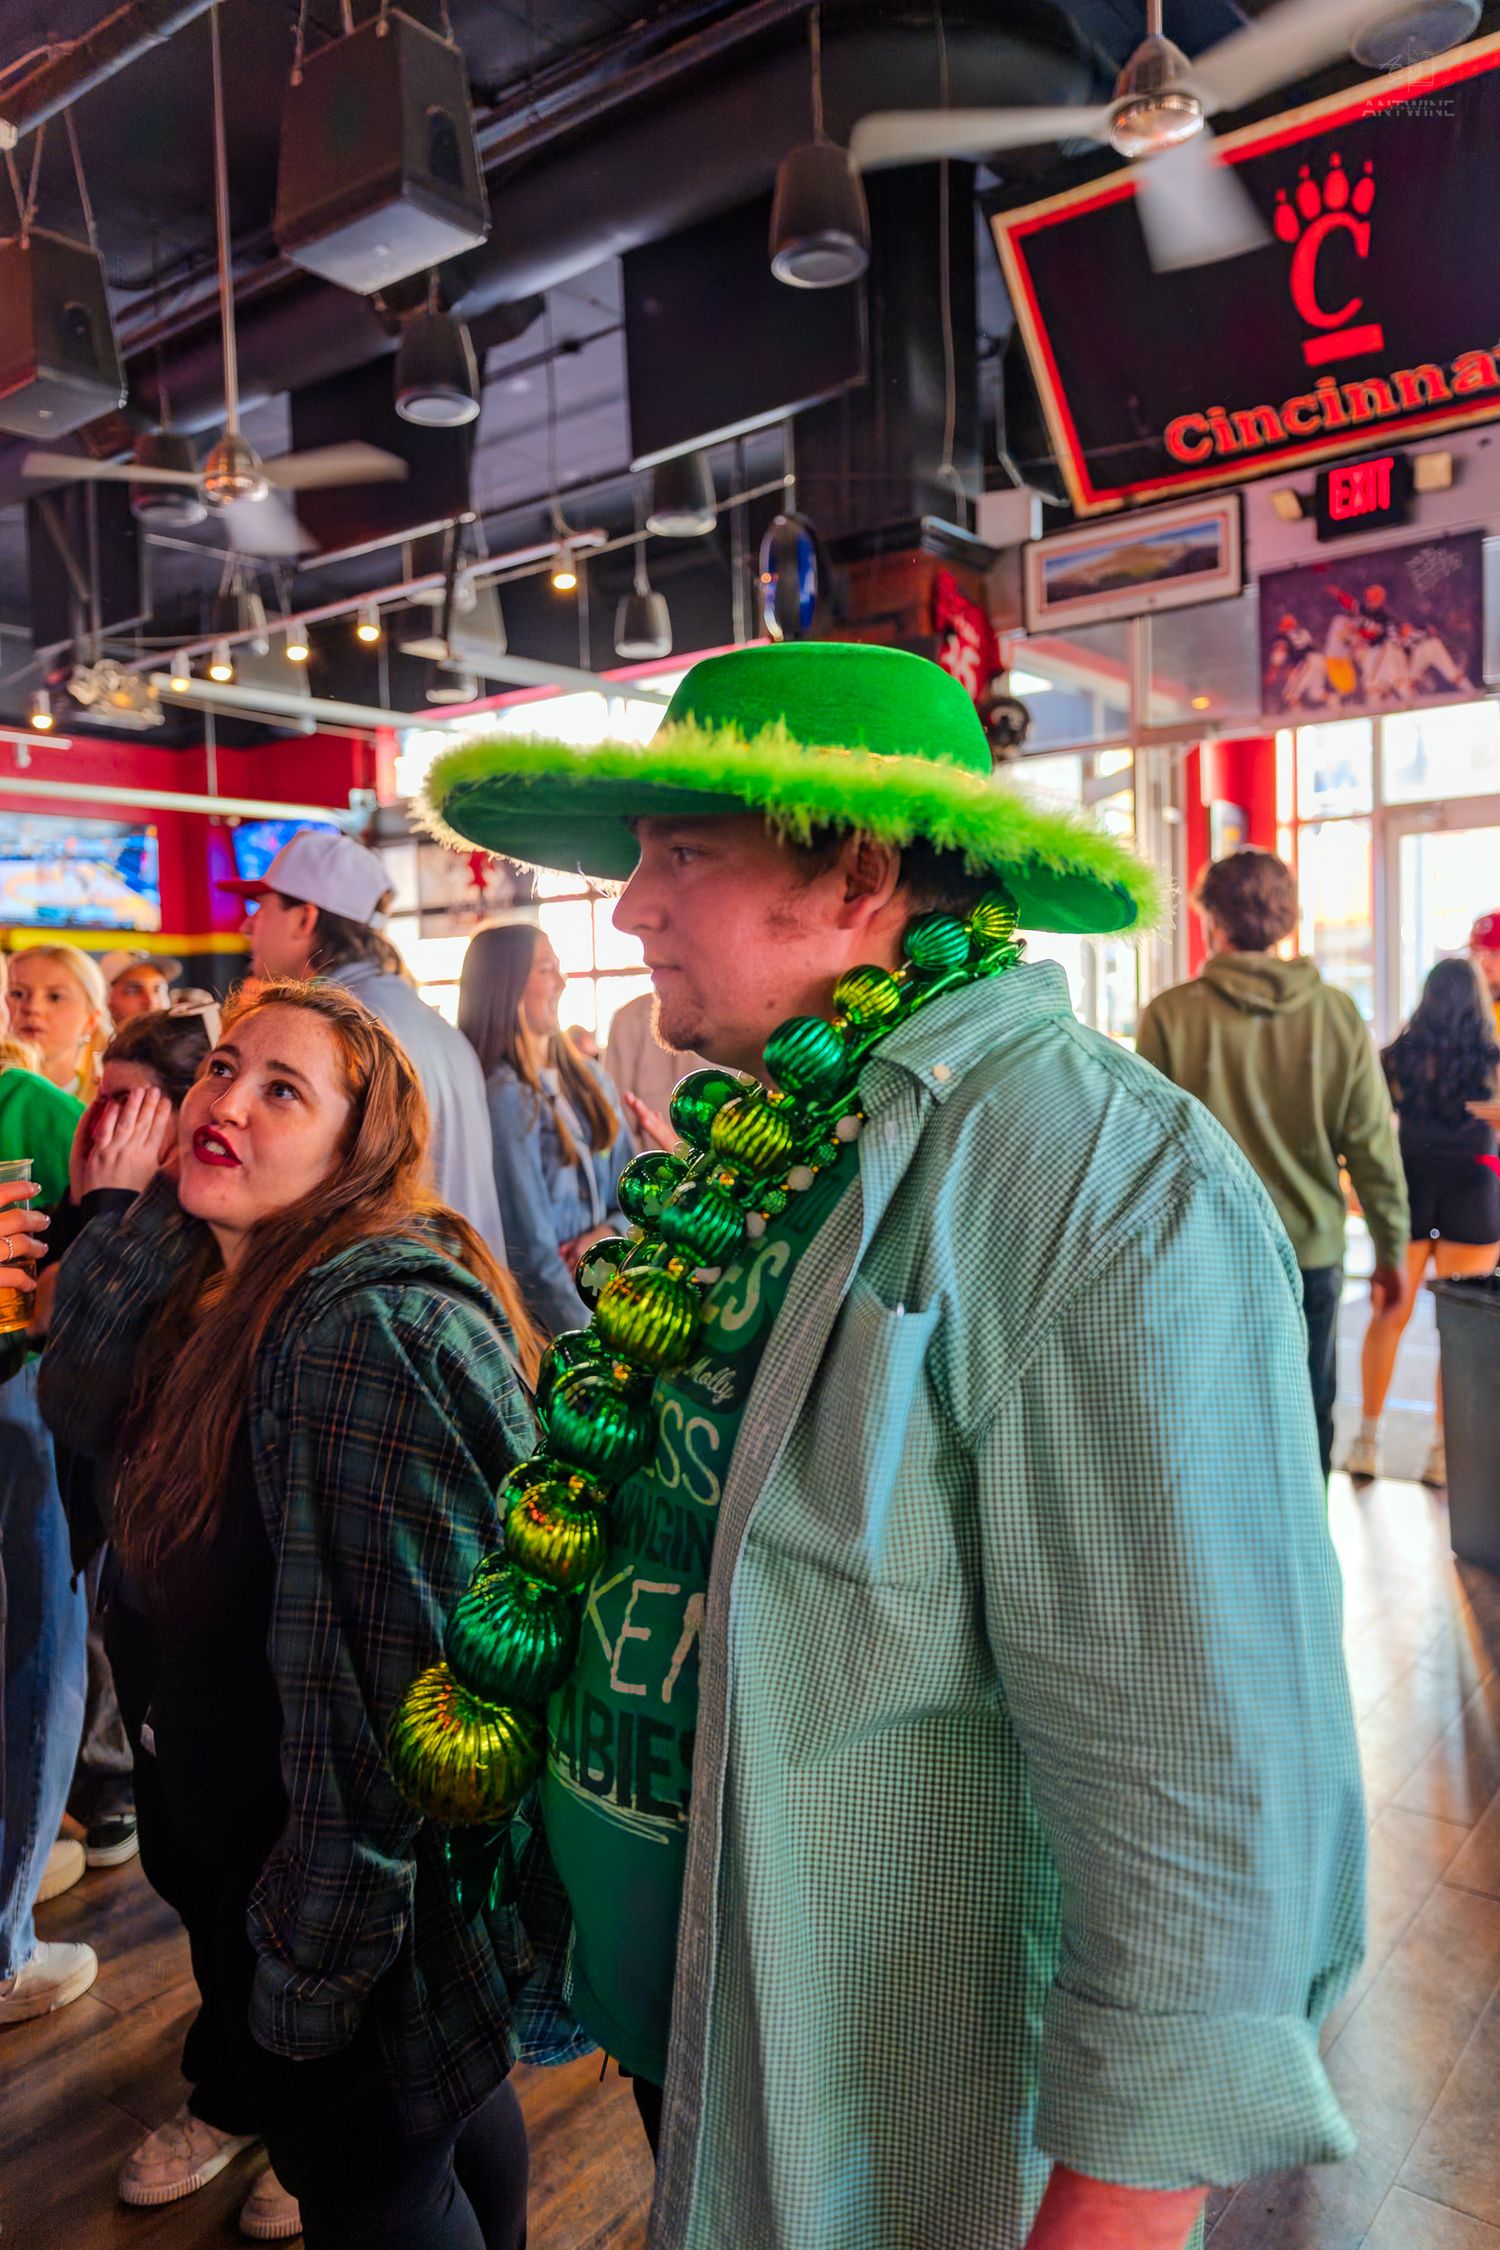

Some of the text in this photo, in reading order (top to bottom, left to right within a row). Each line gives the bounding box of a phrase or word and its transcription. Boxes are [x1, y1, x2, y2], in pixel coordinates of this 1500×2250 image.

[1290, 211, 1371, 328] C
[1164, 345, 1500, 463] Cincinna
[1328, 457, 1394, 520] EXIT
[642, 1399, 721, 1507] SS
